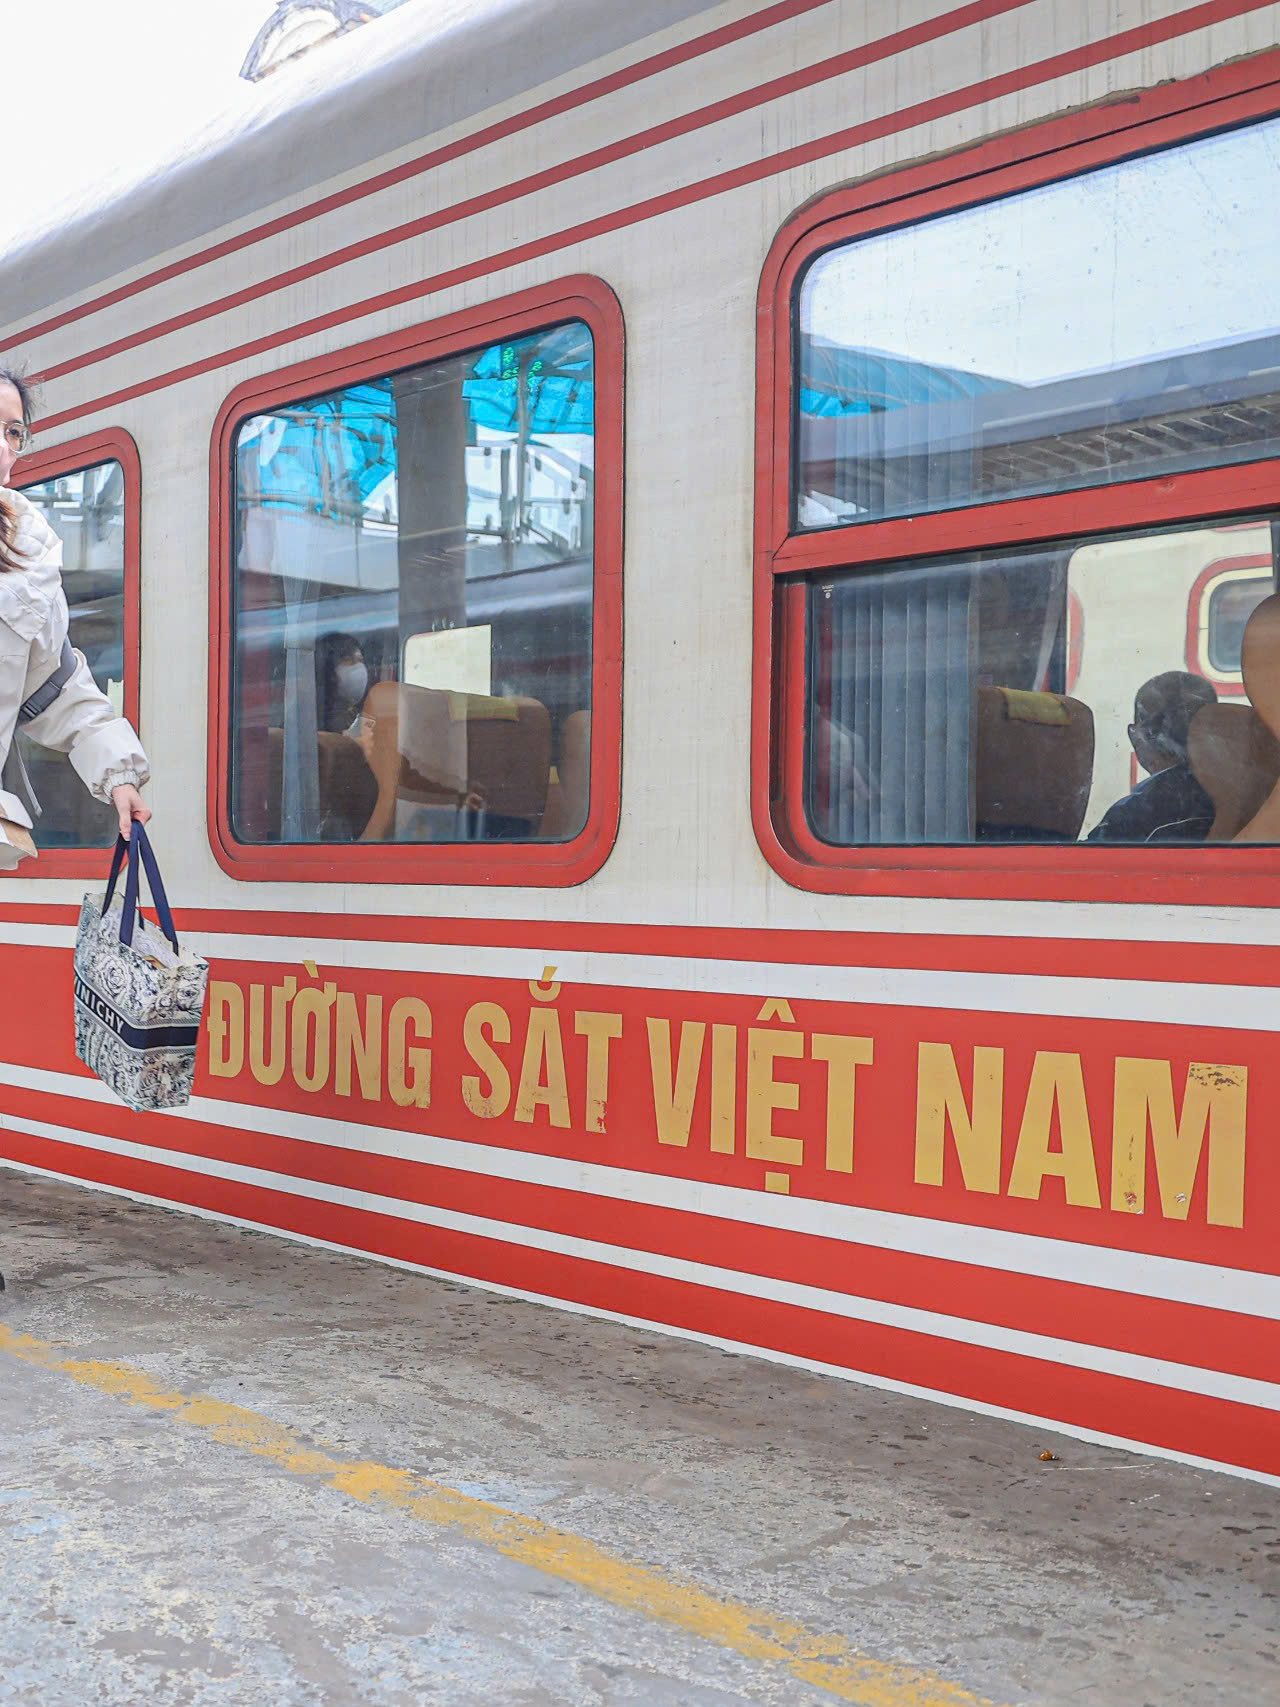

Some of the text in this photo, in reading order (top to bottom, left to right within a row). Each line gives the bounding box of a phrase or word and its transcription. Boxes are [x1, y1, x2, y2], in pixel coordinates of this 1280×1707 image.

[207, 959, 1248, 1229] ĐƯỜNG SẮT VIỆT NAM
